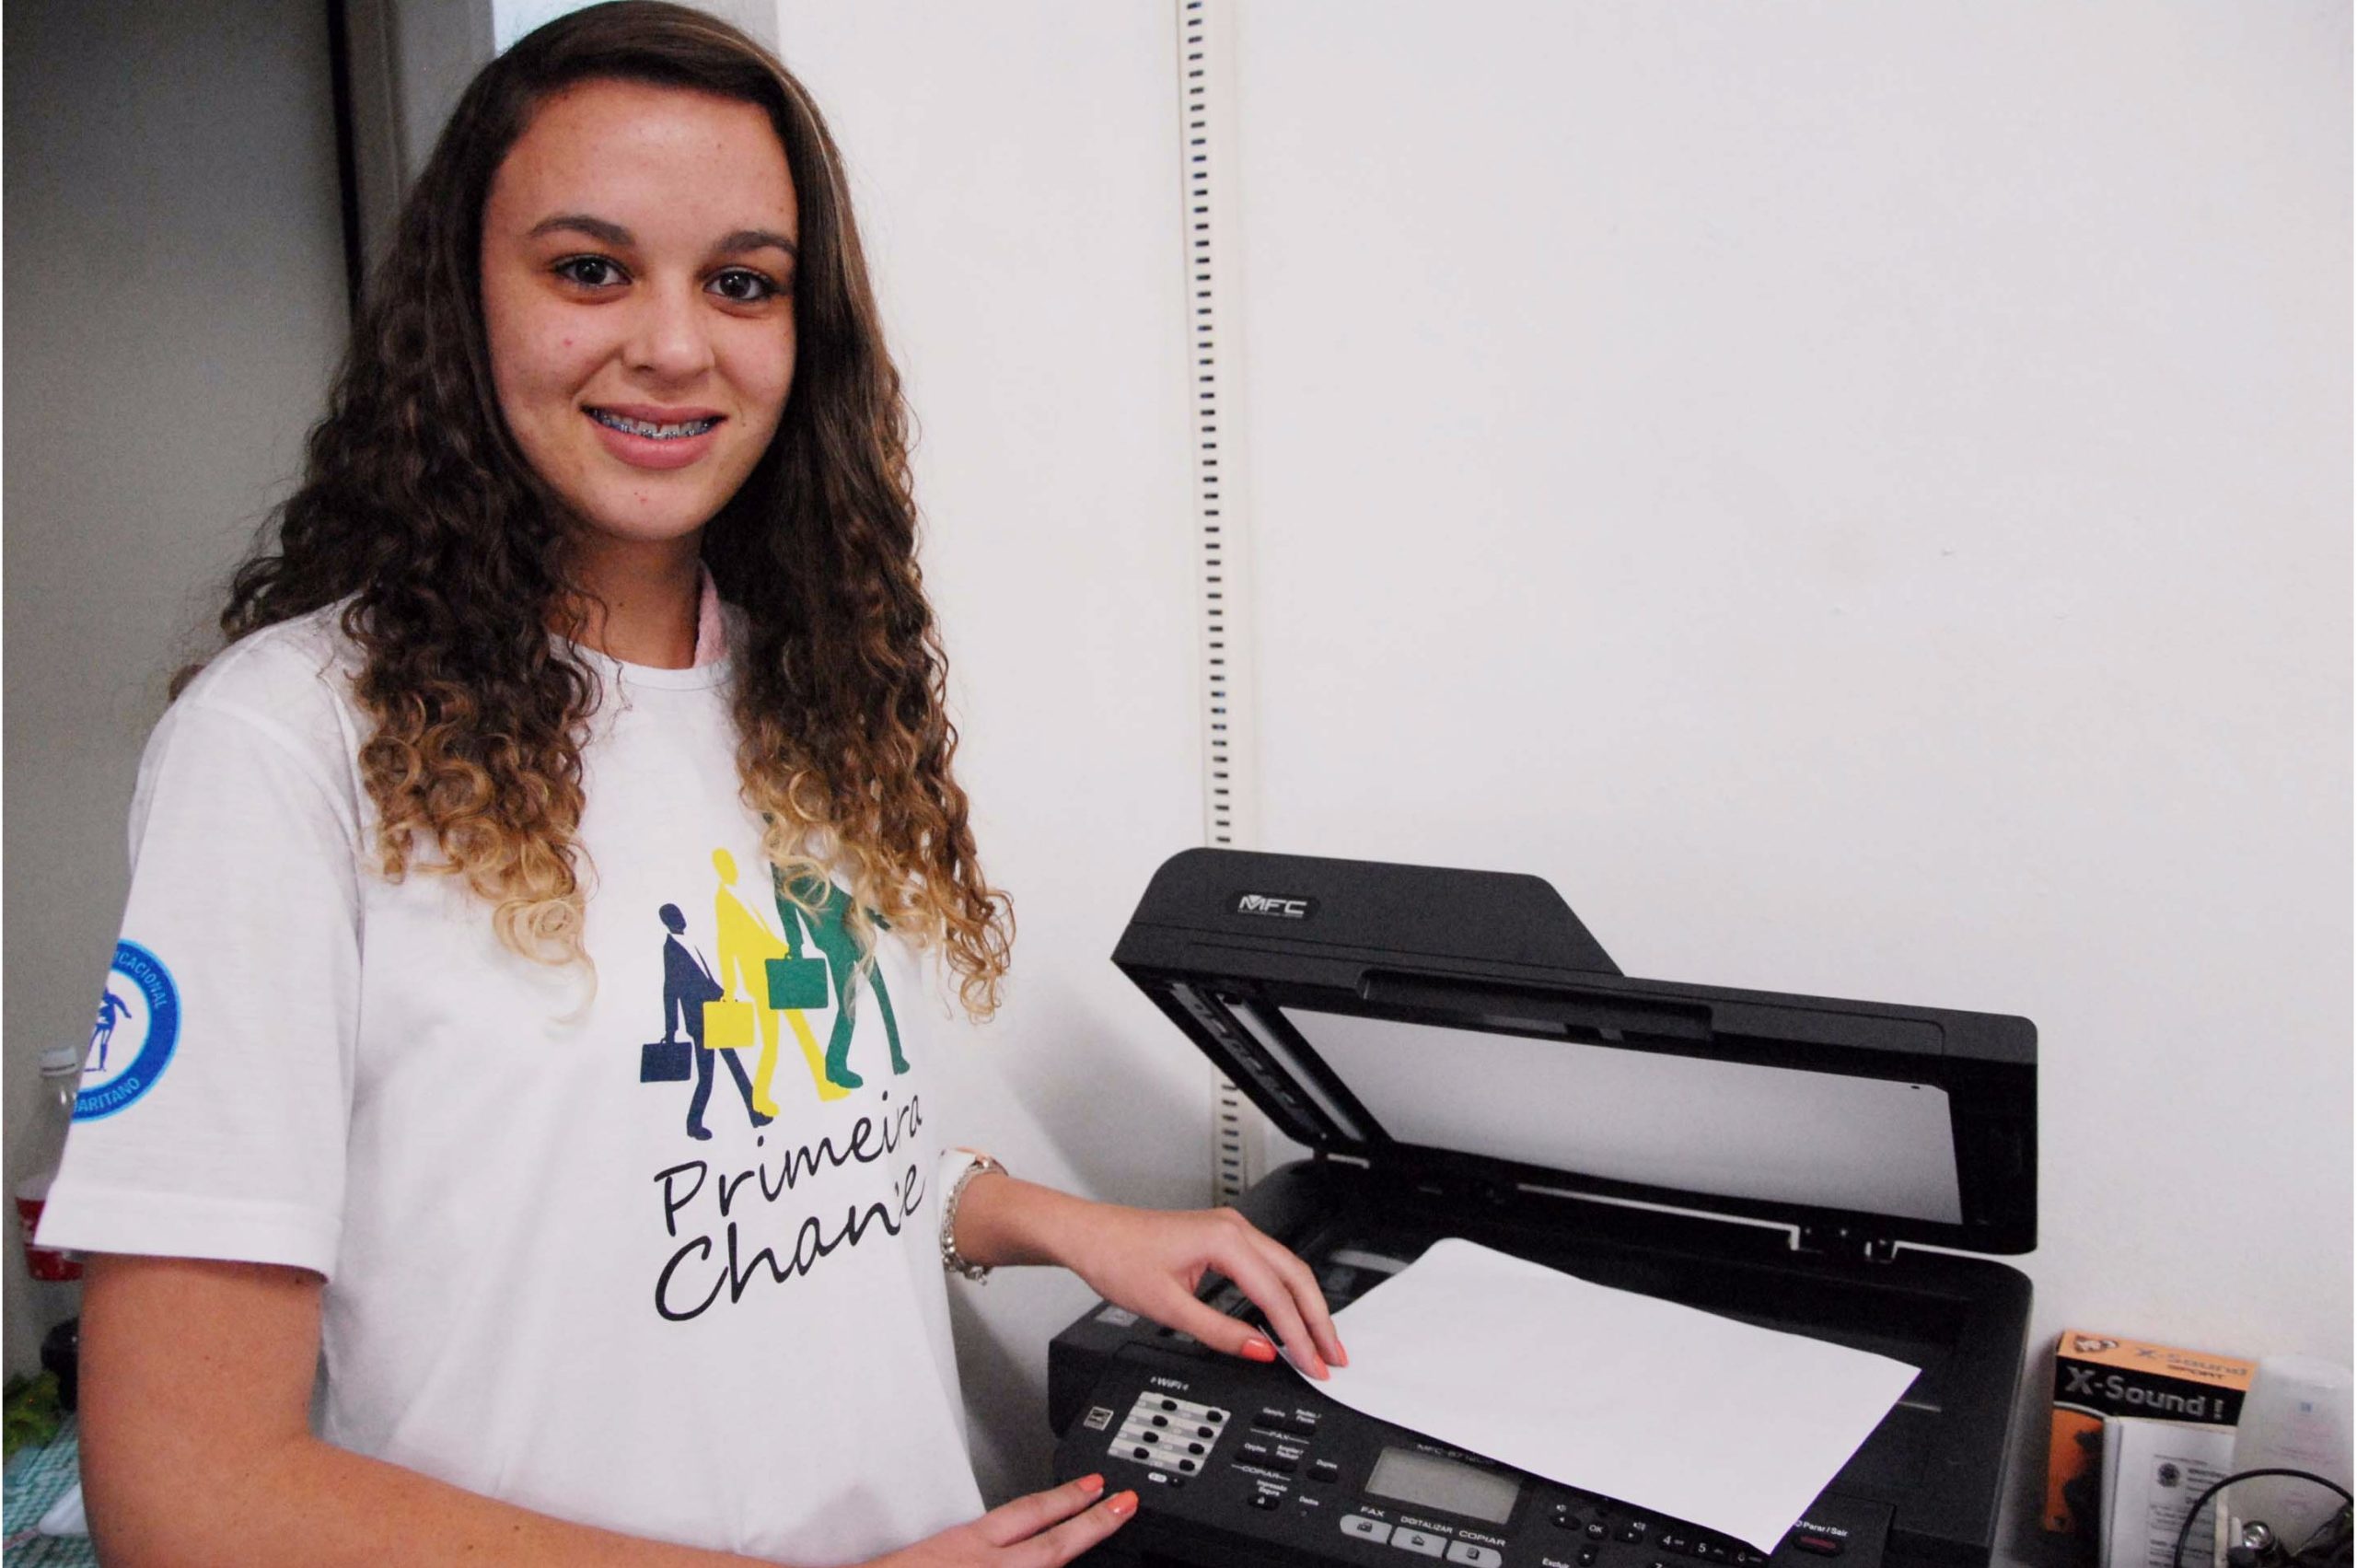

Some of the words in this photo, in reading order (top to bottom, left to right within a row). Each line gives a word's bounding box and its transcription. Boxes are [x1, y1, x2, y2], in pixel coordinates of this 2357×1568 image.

[1238, 894, 1307, 916] MFC
[654, 1090, 923, 1237] Primeira
[655, 1164, 926, 1321] Chane
[2065, 1366, 2206, 1417] X-Sound
[1360, 1505, 1386, 1518] FAX
[1399, 1516, 1454, 1534] DIGITALIZAR
[1588, 1524, 1604, 1534] OK
[1458, 1529, 1506, 1547] COPIAR
